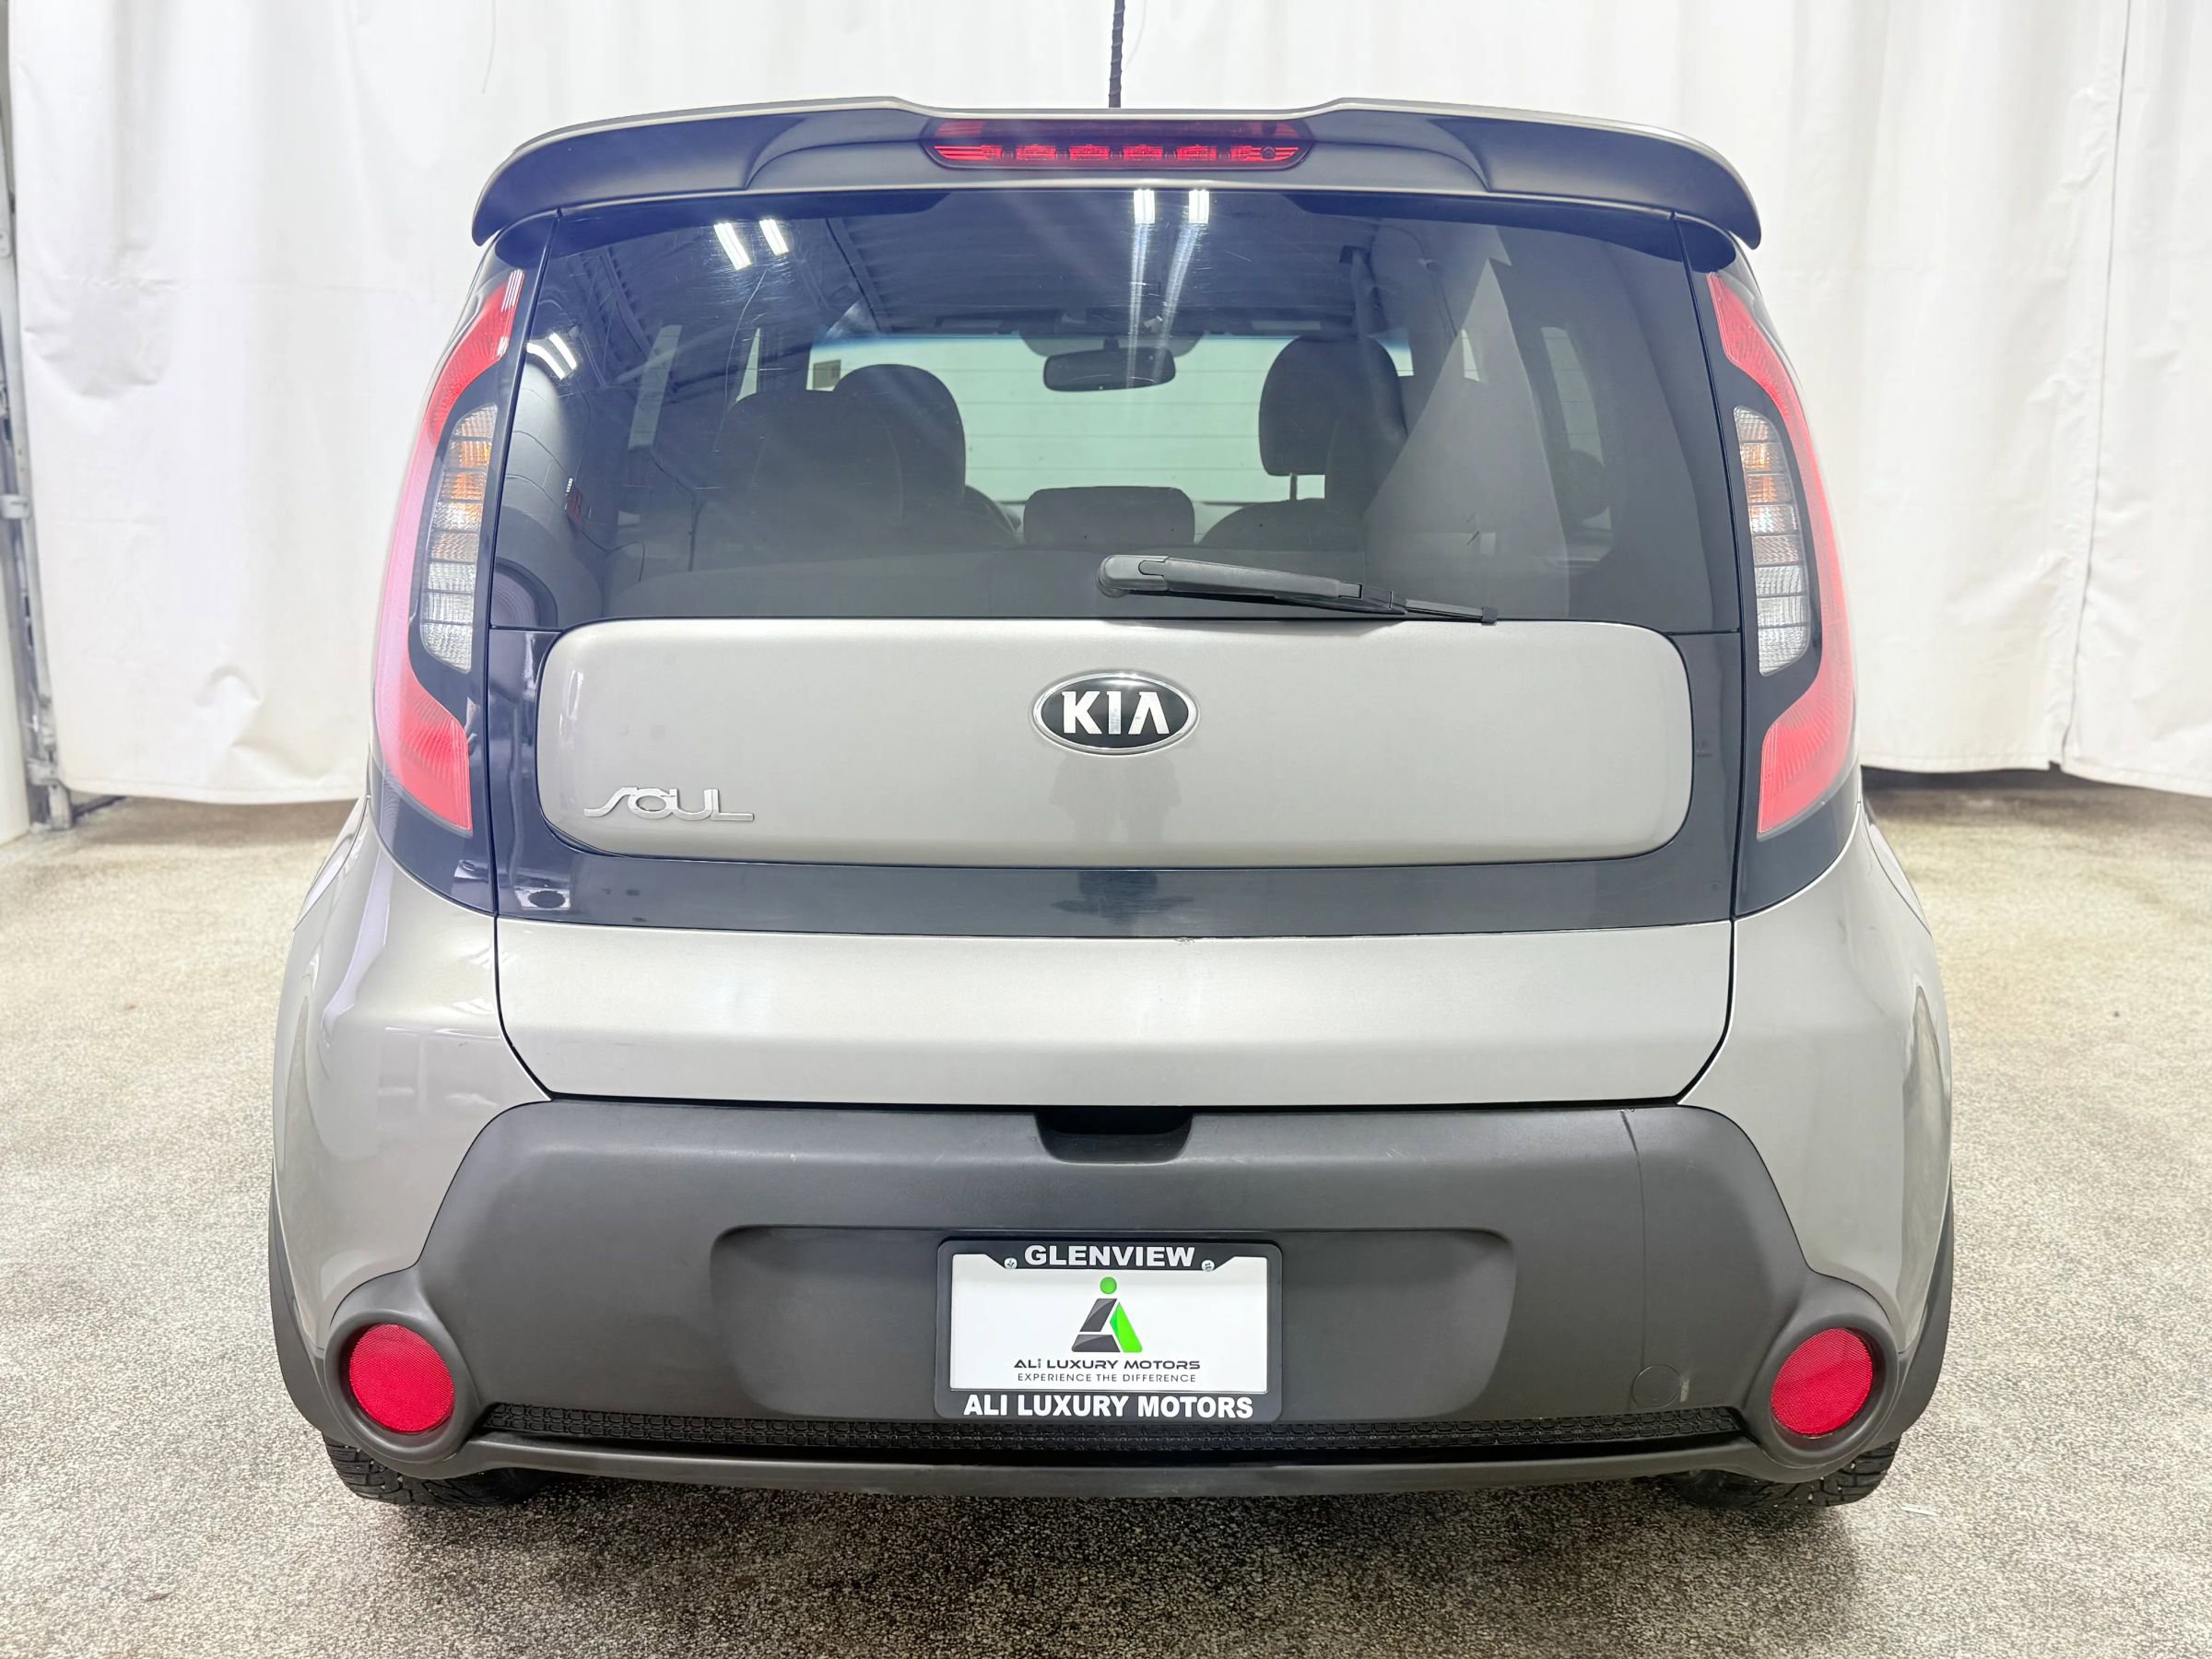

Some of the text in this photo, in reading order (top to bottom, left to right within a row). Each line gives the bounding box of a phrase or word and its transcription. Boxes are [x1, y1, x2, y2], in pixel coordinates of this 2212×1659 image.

[1061, 690, 1171, 735] KIA
[582, 785, 756, 822] SOUL
[1024, 1244, 1195, 1267] GLENVIEW
[1018, 1372, 1197, 1382] EXPERIENCE THE DIFFERENCE
[1046, 1359, 1119, 1370] LUXURY
[1124, 1359, 1201, 1371] MOTORS
[963, 1394, 1254, 1419] ALI LUXURY MOTORS
